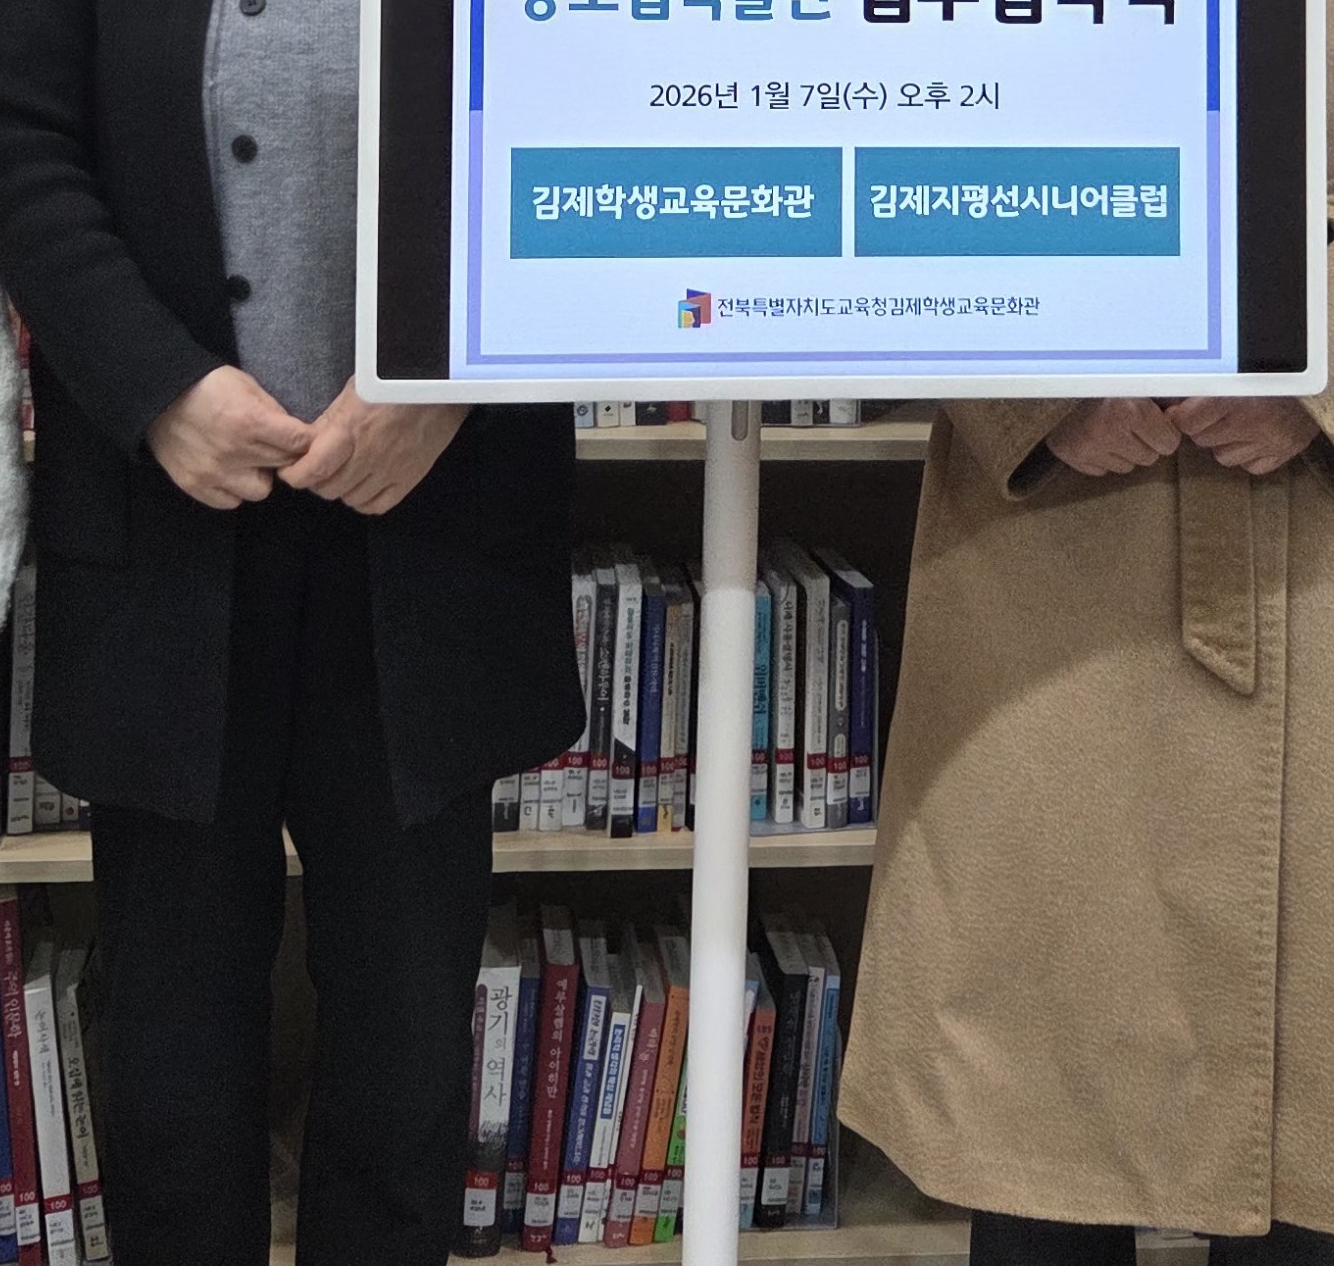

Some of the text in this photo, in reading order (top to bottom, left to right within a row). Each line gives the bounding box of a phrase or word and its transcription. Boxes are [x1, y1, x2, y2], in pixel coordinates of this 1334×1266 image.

[649, 80, 1000, 113] 2026년 1월 7일(수) 오후 2시
[531, 182, 1169, 220] 김제학생교육문화관 김제지평선시니어클럽
[716, 294, 1041, 319] 전북특별자치도교육청김제학생교육문화관
[484, 987, 513, 1107] 광기의 역사
[50, 1200, 66, 1210] 100
